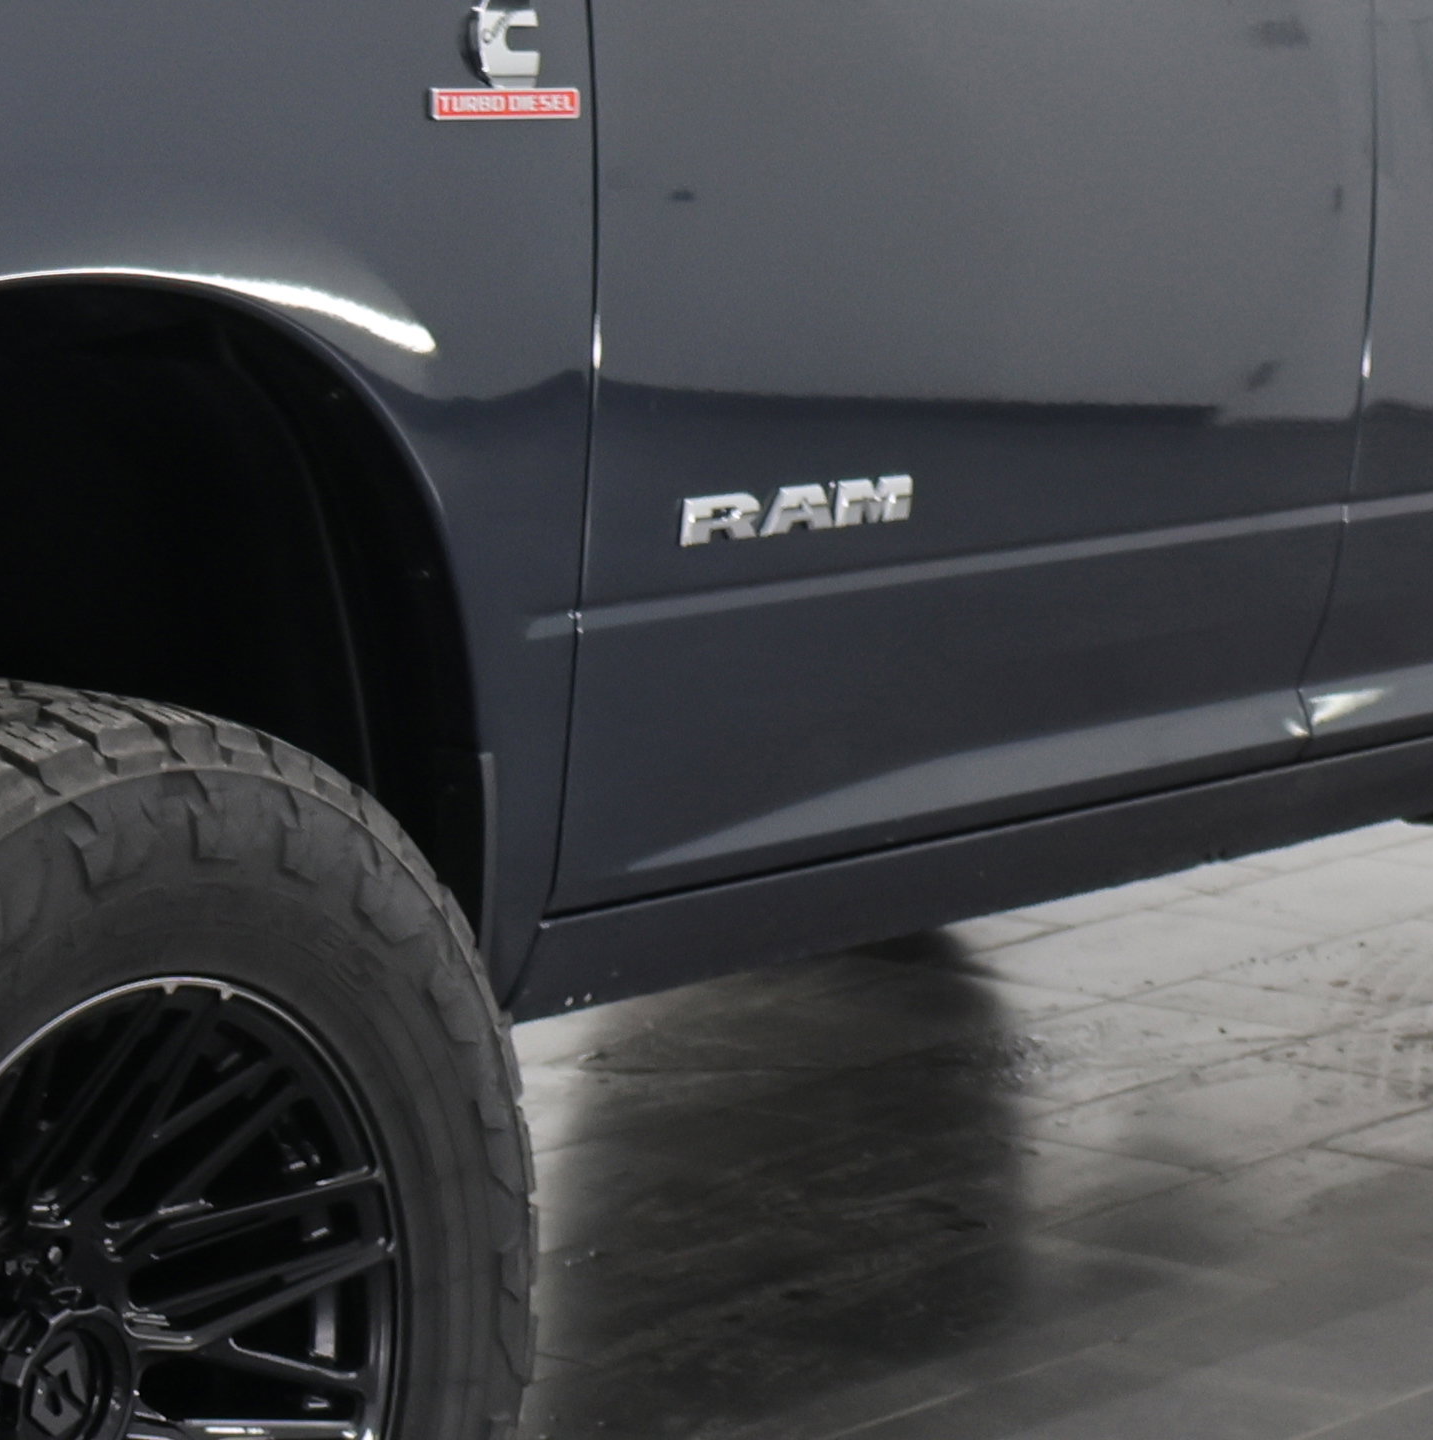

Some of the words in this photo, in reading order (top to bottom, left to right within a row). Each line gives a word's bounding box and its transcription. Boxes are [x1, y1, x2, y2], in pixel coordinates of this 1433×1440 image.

[438, 94, 506, 112] TURBO
[507, 93, 574, 112] DIESEL
[679, 473, 914, 547] RAM
